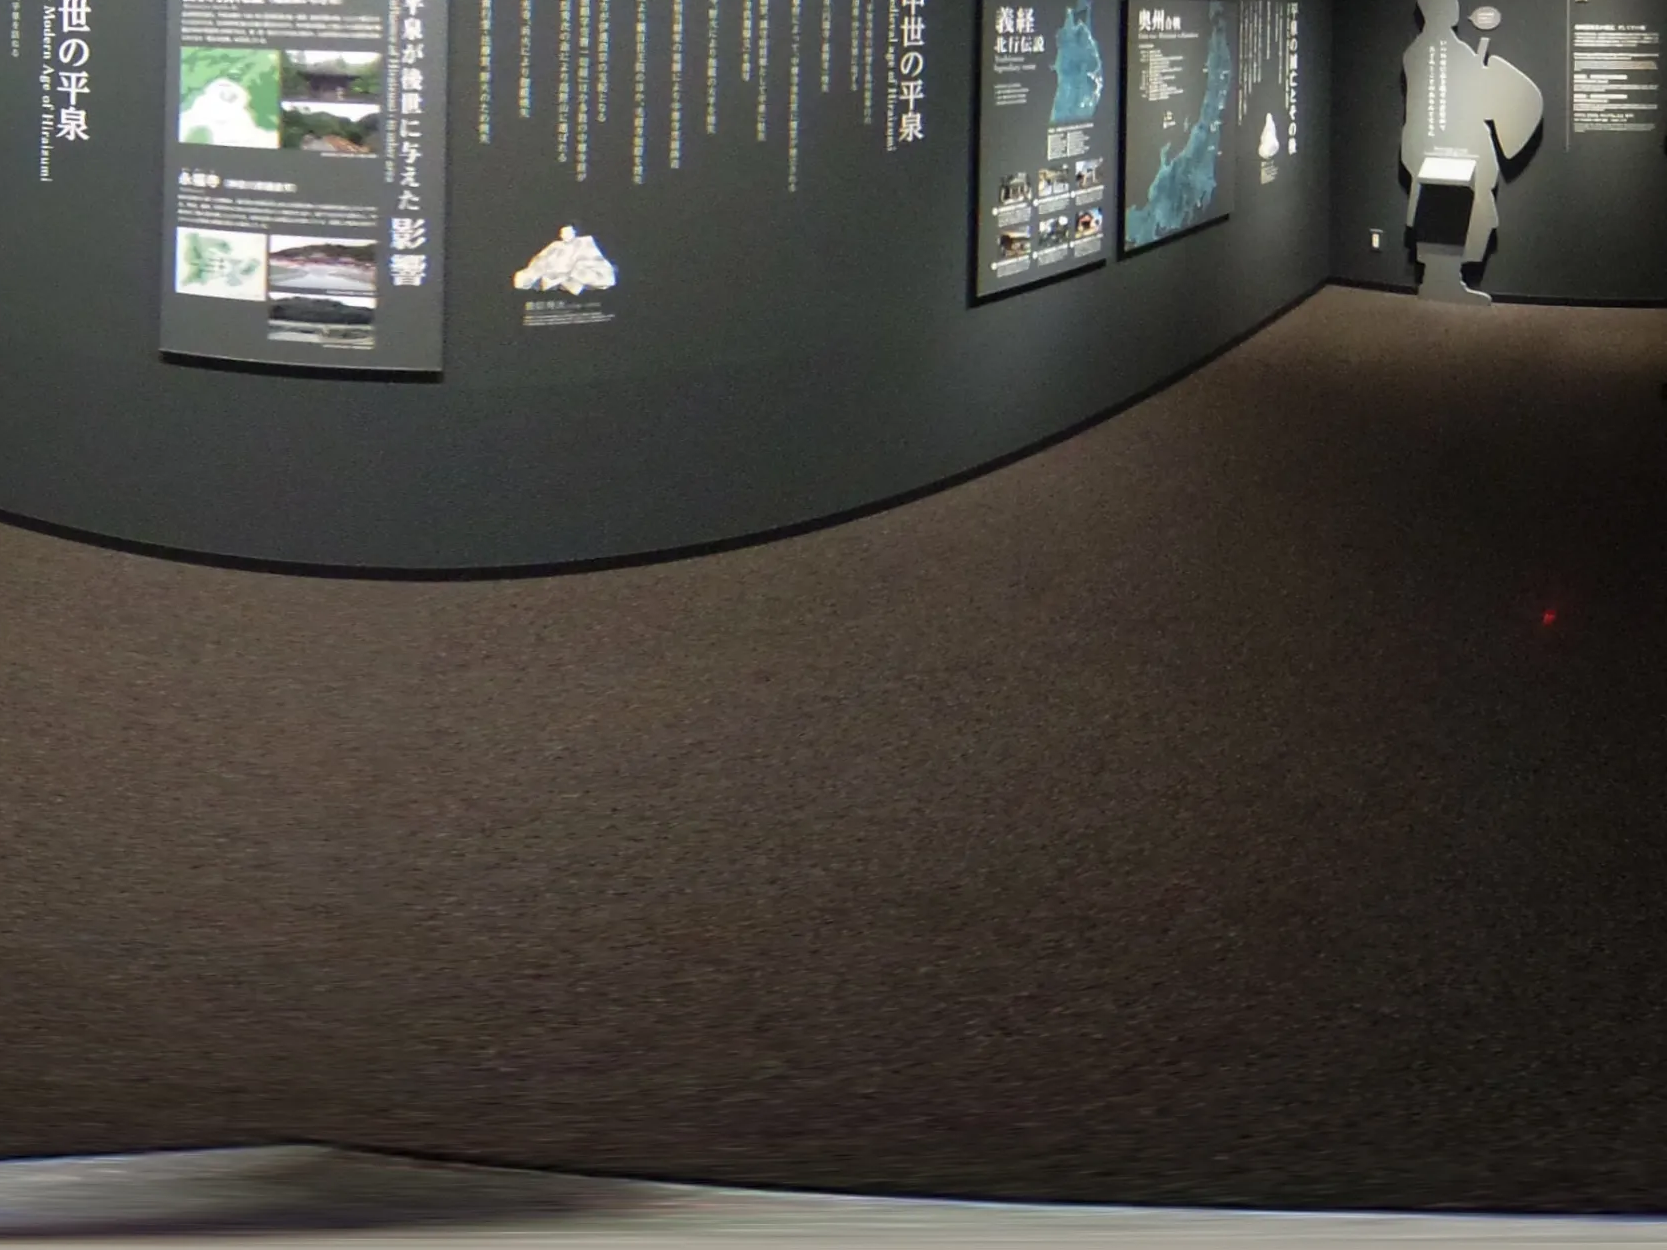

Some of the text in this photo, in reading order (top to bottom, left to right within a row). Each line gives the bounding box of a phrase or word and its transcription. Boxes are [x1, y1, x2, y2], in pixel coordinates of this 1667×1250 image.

[42, 5, 56, 60] Modern
[995, 6, 1035, 34] 義経
[994, 35, 1045, 54] 北行伝説
[40, 63, 55, 91] Age
[41, 95, 55, 111] of
[40, 113, 55, 182] Hiraizumi
[389, 217, 428, 287] 影響
